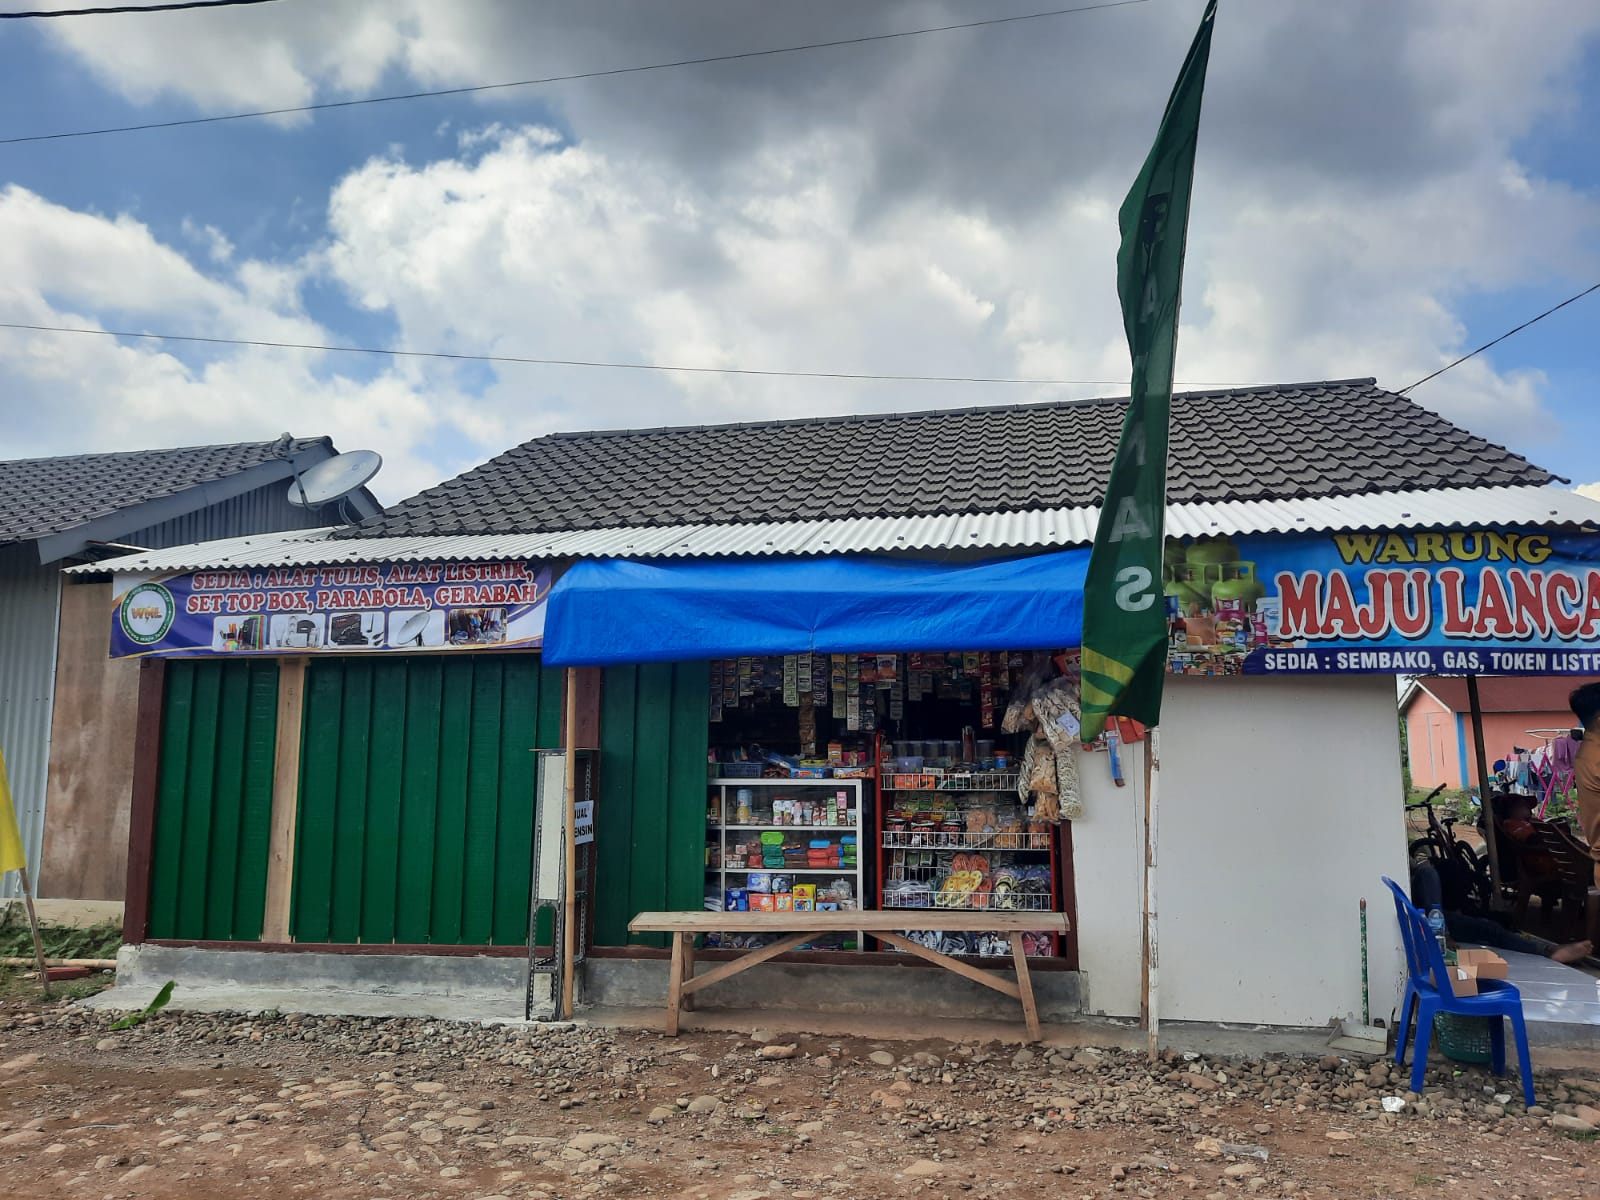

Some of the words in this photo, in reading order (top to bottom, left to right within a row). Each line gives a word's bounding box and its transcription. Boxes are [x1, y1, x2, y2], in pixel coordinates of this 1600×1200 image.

[1333, 532, 1553, 564] WARUNG
[192, 571, 250, 590] SEDIA
[264, 568, 316, 589] ALAT
[320, 566, 384, 587] TULIS,
[386, 563, 443, 585] ALAT
[445, 561, 534, 583] LISTRIK,
[187, 595, 223, 614] SET
[226, 592, 265, 612] TOP
[267, 590, 314, 613] BOX,
[317, 587, 432, 610] PARABOLA,
[435, 583, 537, 606] GERABAH
[1275, 569, 1432, 639] MAJU
[1264, 653, 1318, 670] SEDIA
[1337, 651, 1437, 671] SEMBAKO,
[1444, 653, 1485, 672] GAS,
[1491, 653, 1546, 671] TOKEN
[575, 824, 592, 837] ENSIN
